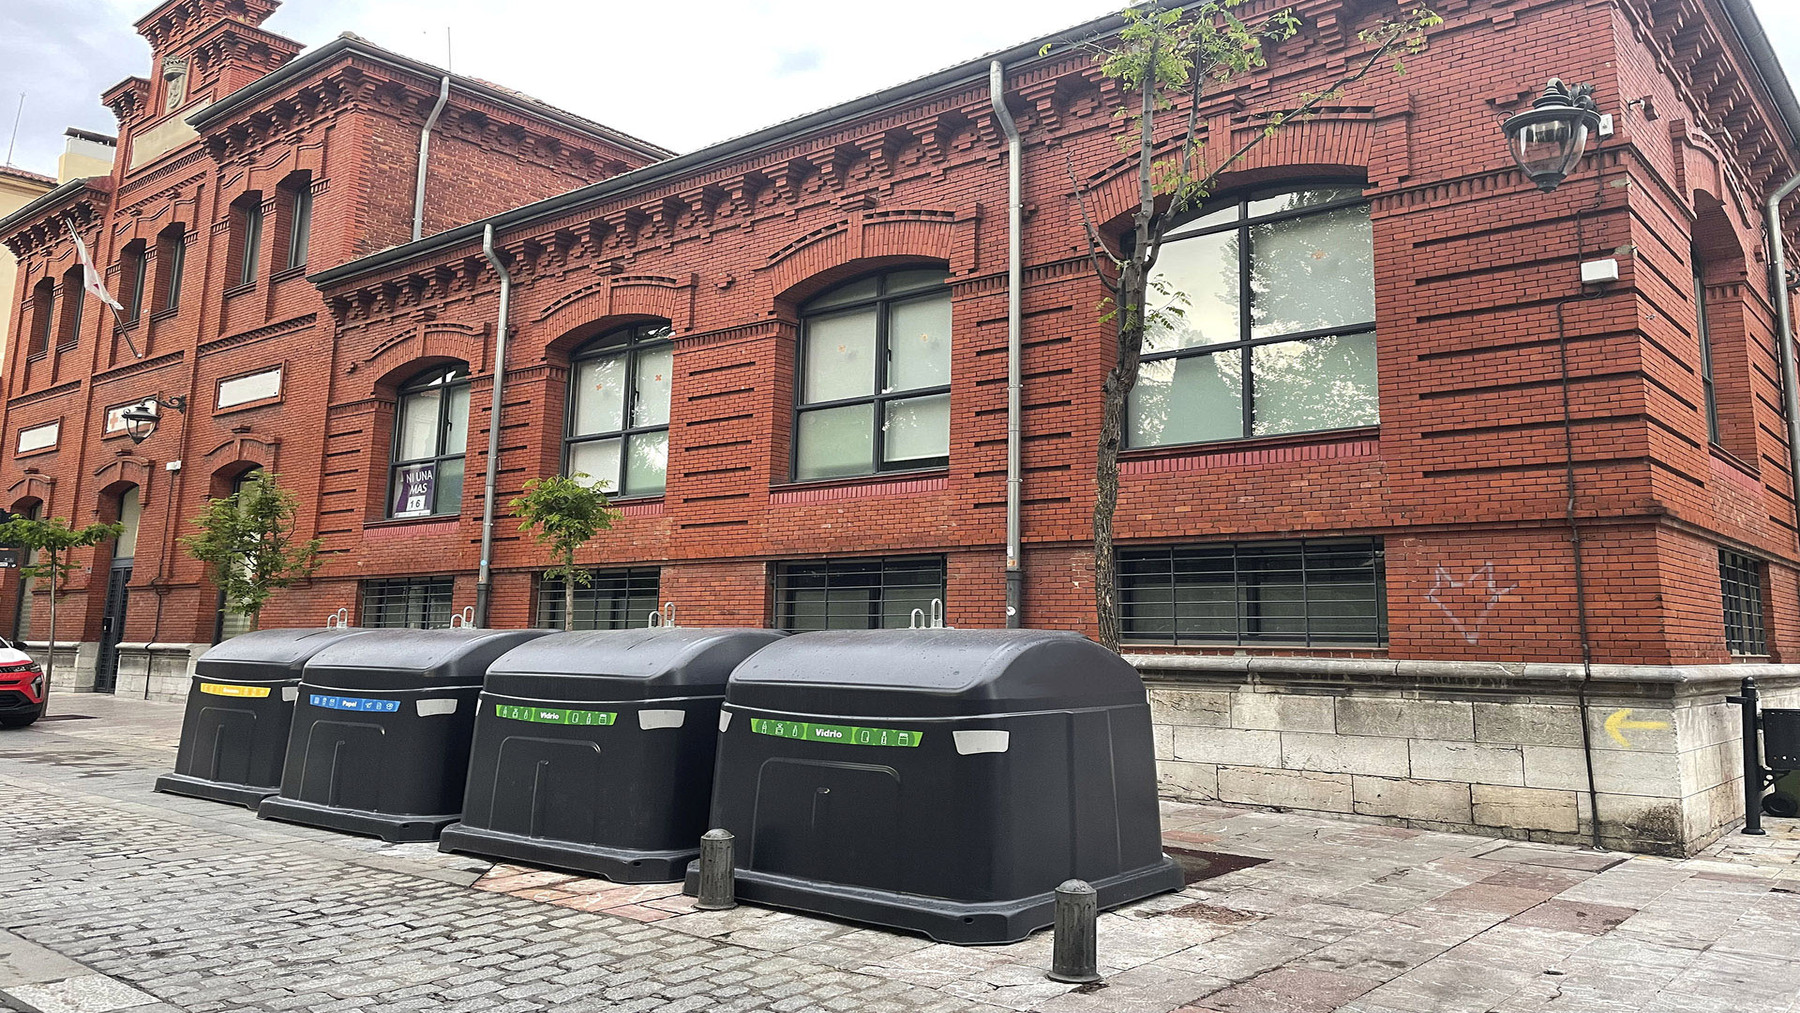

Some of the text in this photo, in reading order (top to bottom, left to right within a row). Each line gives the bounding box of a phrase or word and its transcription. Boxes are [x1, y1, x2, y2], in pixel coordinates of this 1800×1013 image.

[406, 470, 433, 484] NI UNA
[410, 499, 421, 508] 16
[540, 711, 560, 720] Vidrio
[815, 728, 843, 738] Vidrio
